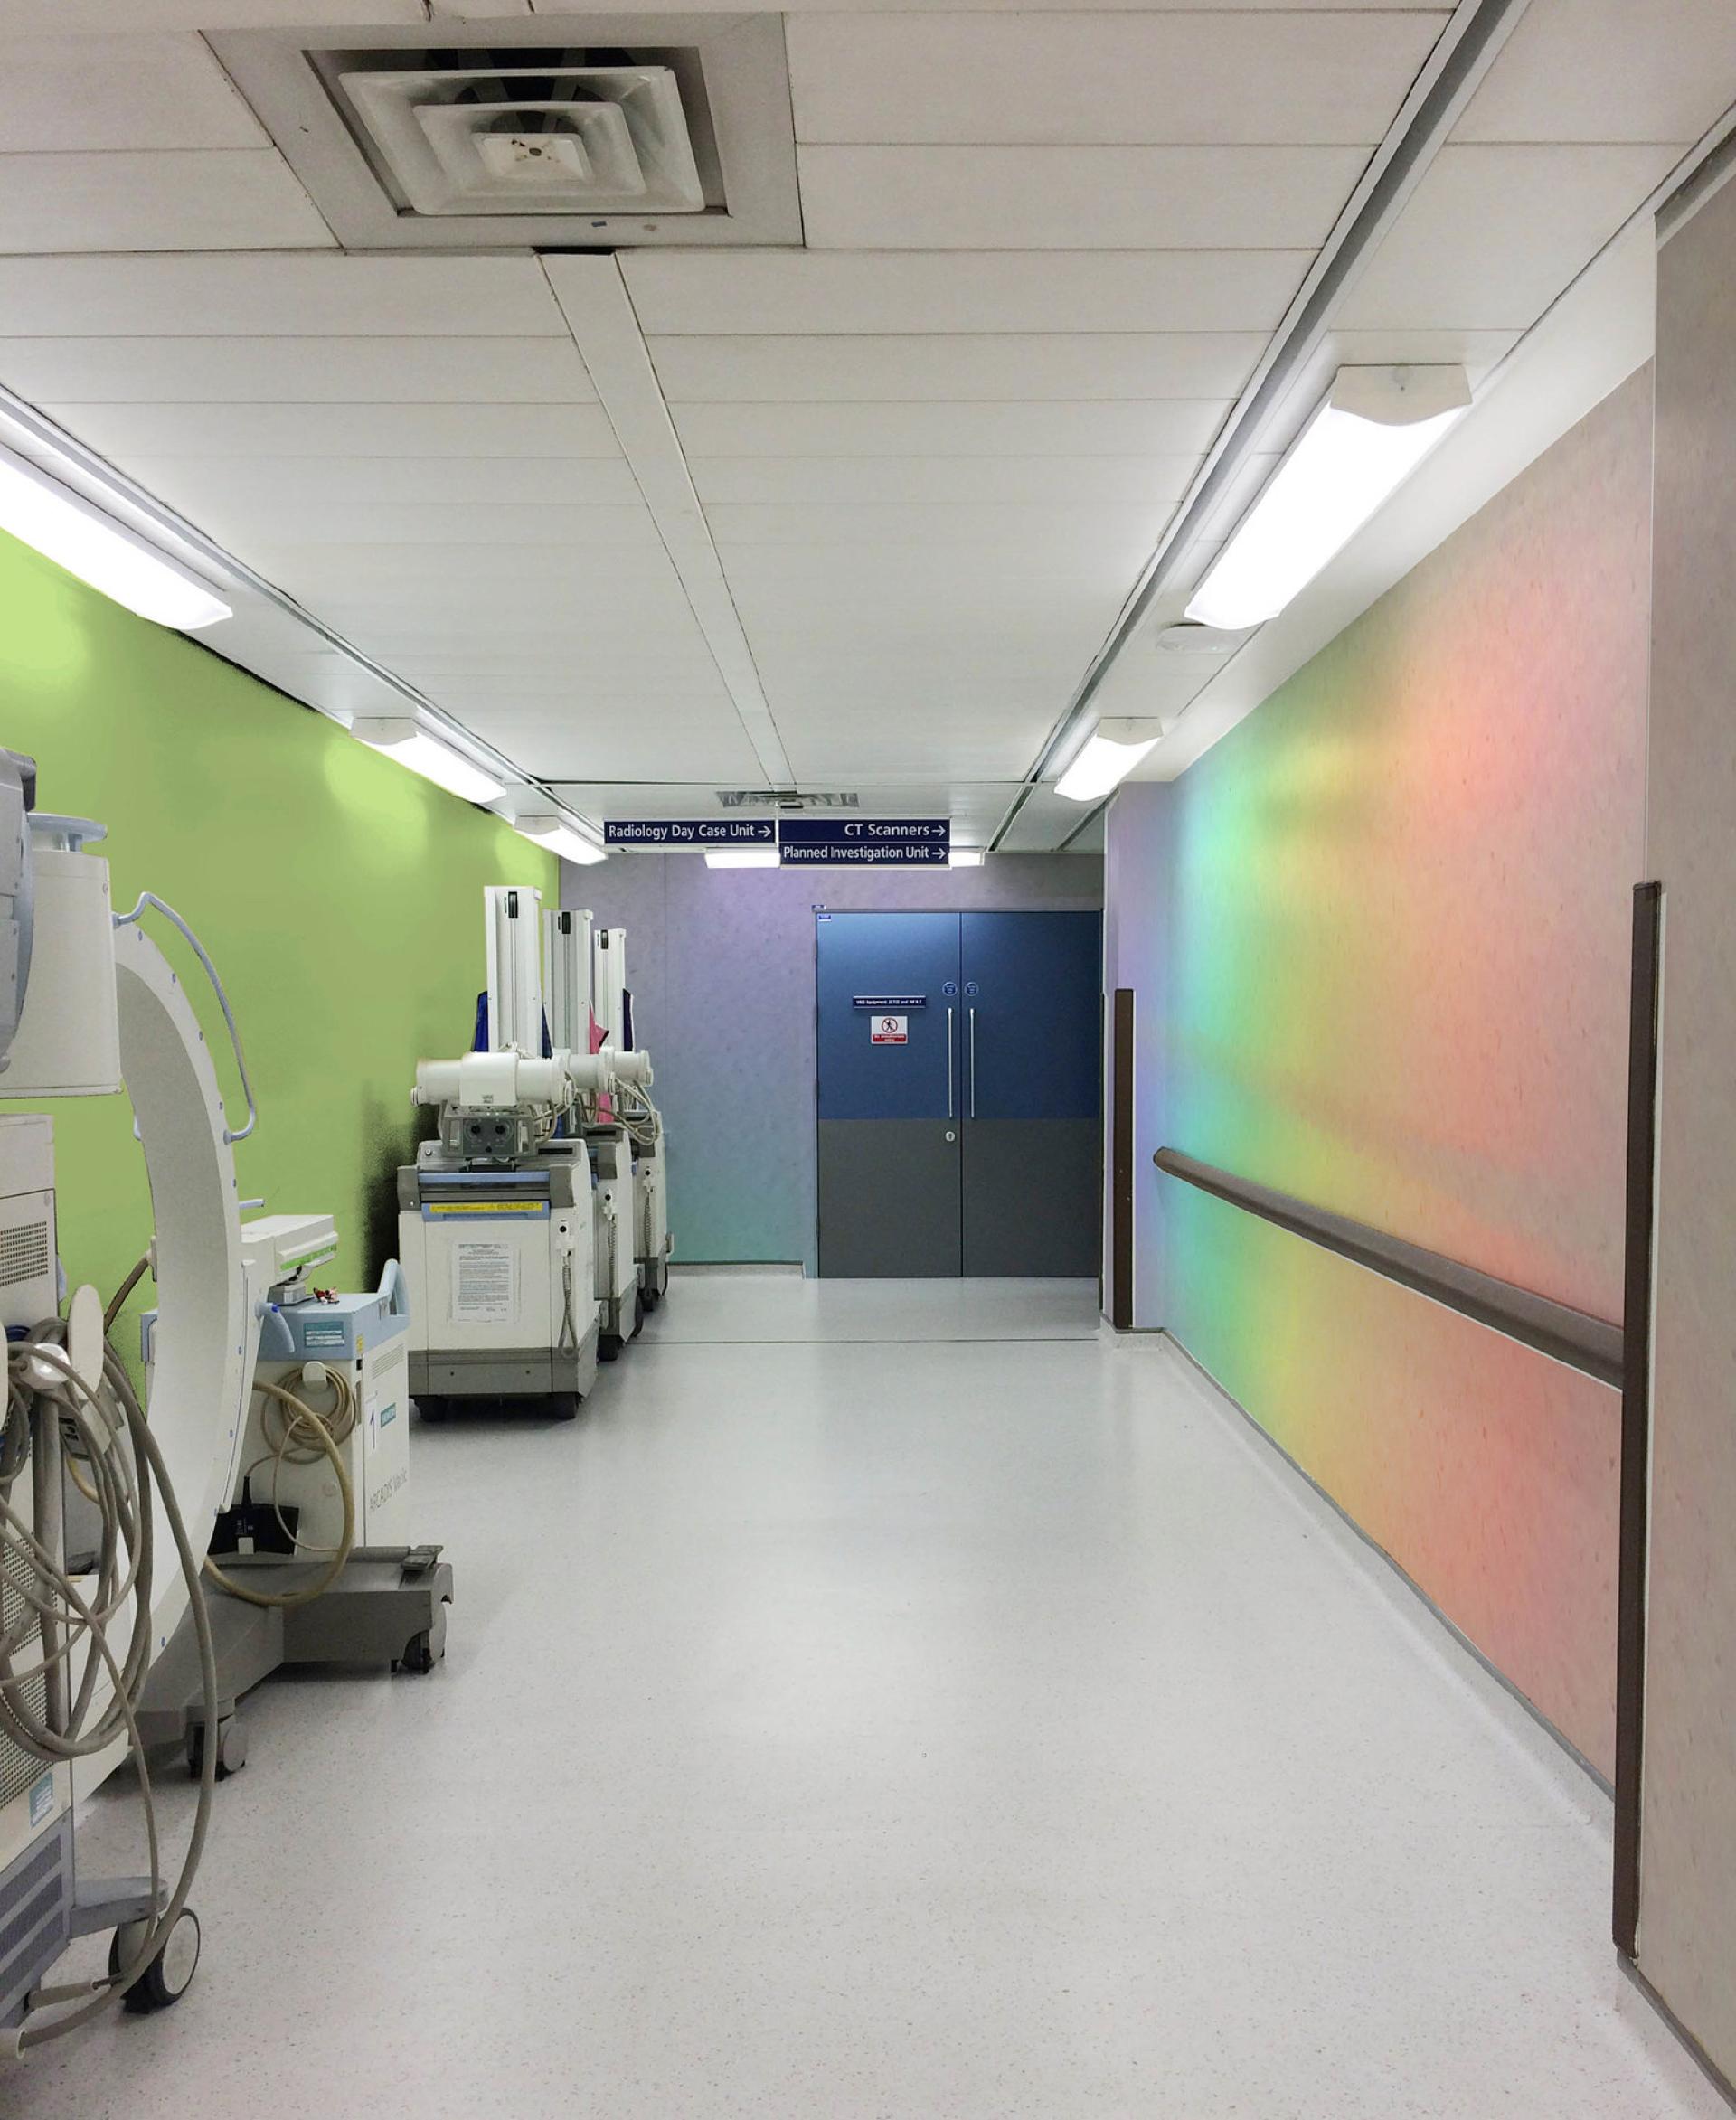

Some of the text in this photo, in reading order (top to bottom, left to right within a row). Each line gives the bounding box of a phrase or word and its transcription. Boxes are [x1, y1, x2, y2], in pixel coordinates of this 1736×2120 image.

[609, 824, 754, 840] Radiology Day Case Unit
[845, 824, 929, 835] CT Scanners
[784, 846, 929, 861] Planned Investigation Unit
